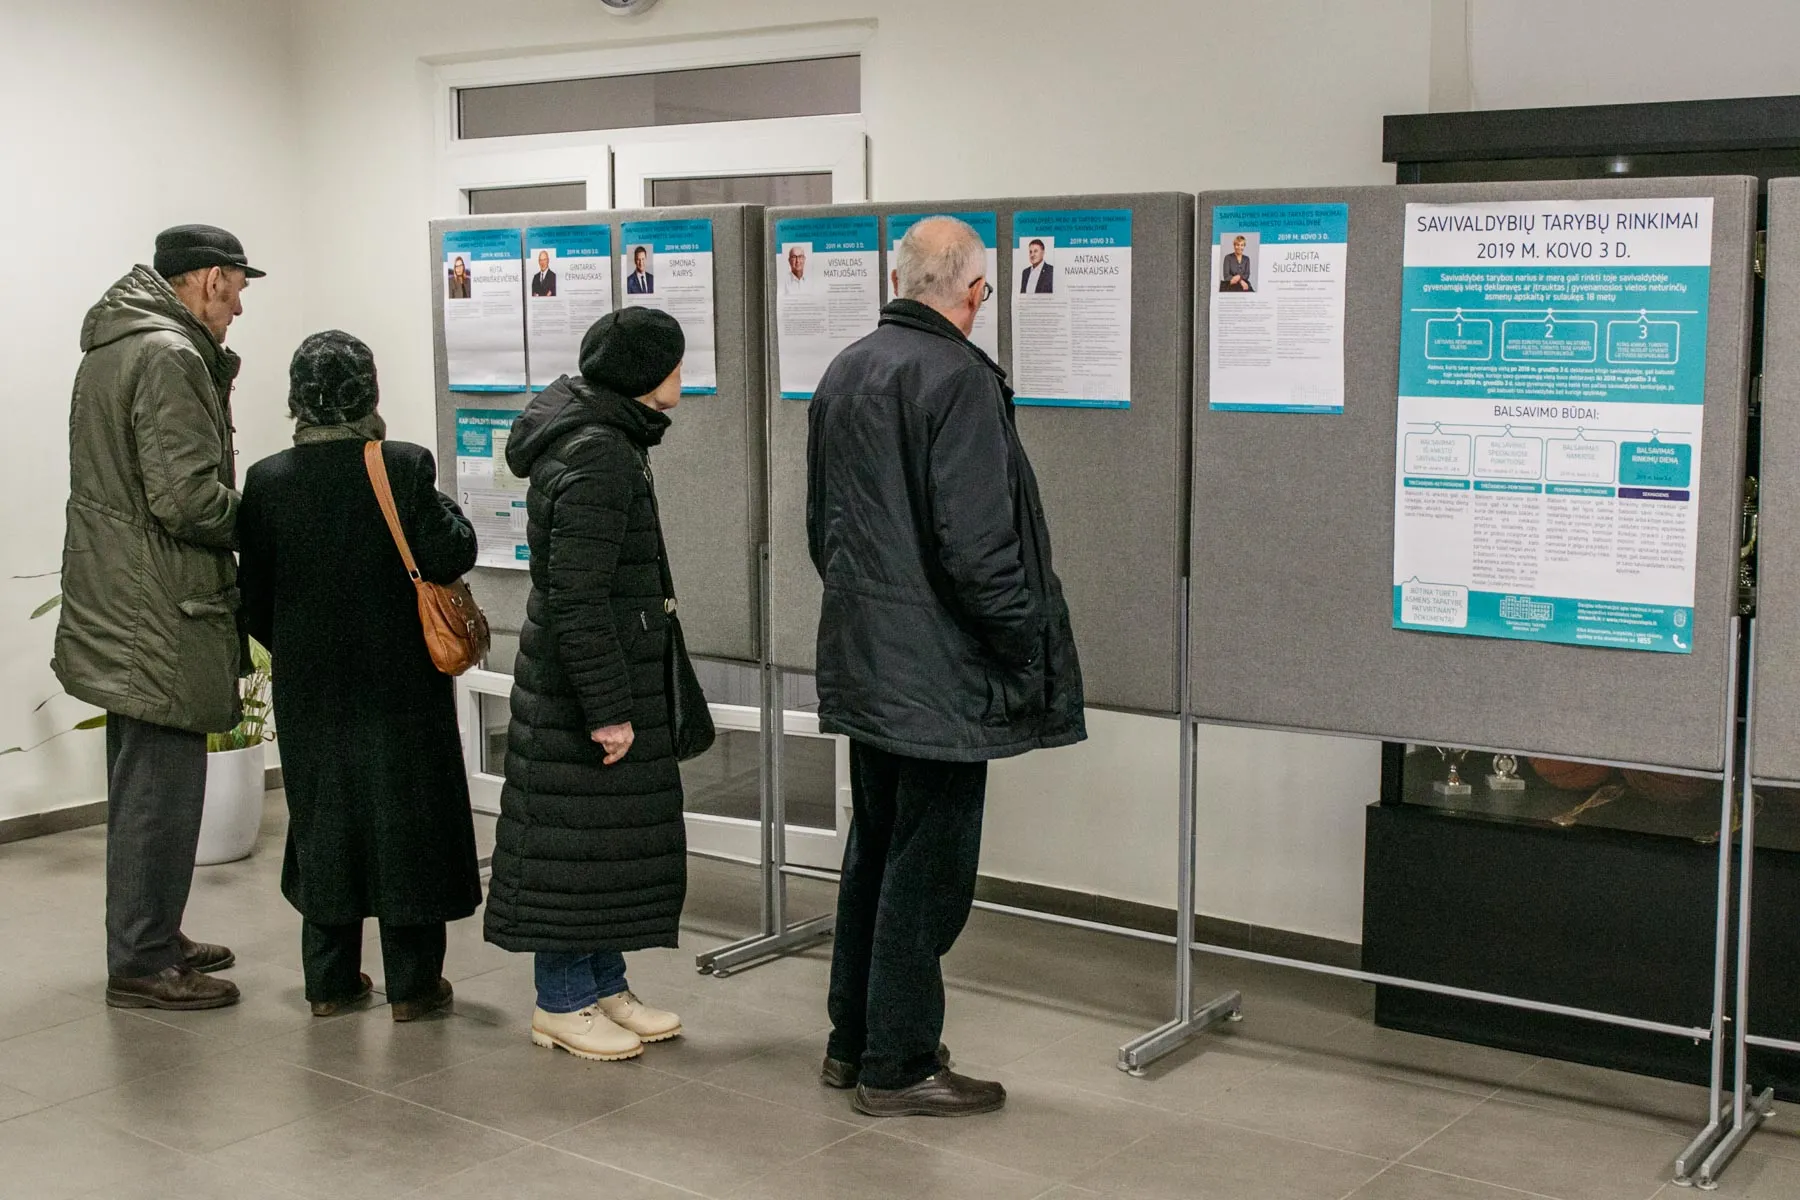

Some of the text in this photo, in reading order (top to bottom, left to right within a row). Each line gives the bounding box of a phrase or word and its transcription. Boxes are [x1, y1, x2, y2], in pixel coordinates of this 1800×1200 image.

[1418, 212, 1698, 235] SAVIVALDYBIŲ TARYBŲ RINKIMAI
[1285, 251, 1319, 260] JURGITA
[1477, 242, 1630, 258] 2019 M. KOVO 3 D.
[828, 258, 862, 267] VISVALDAS
[1074, 255, 1110, 263] ANTANAS
[824, 268, 867, 277] MATIJOŠAITIS
[1064, 266, 1119, 275] NAVAKAUSKAS
[1457, 323, 1462, 336] 1
[1545, 324, 1554, 338] 2
[1639, 325, 1648, 339] 3
[1494, 405, 1599, 420] BALSAVIMO BŪDAI:
[463, 492, 469, 504] 2
